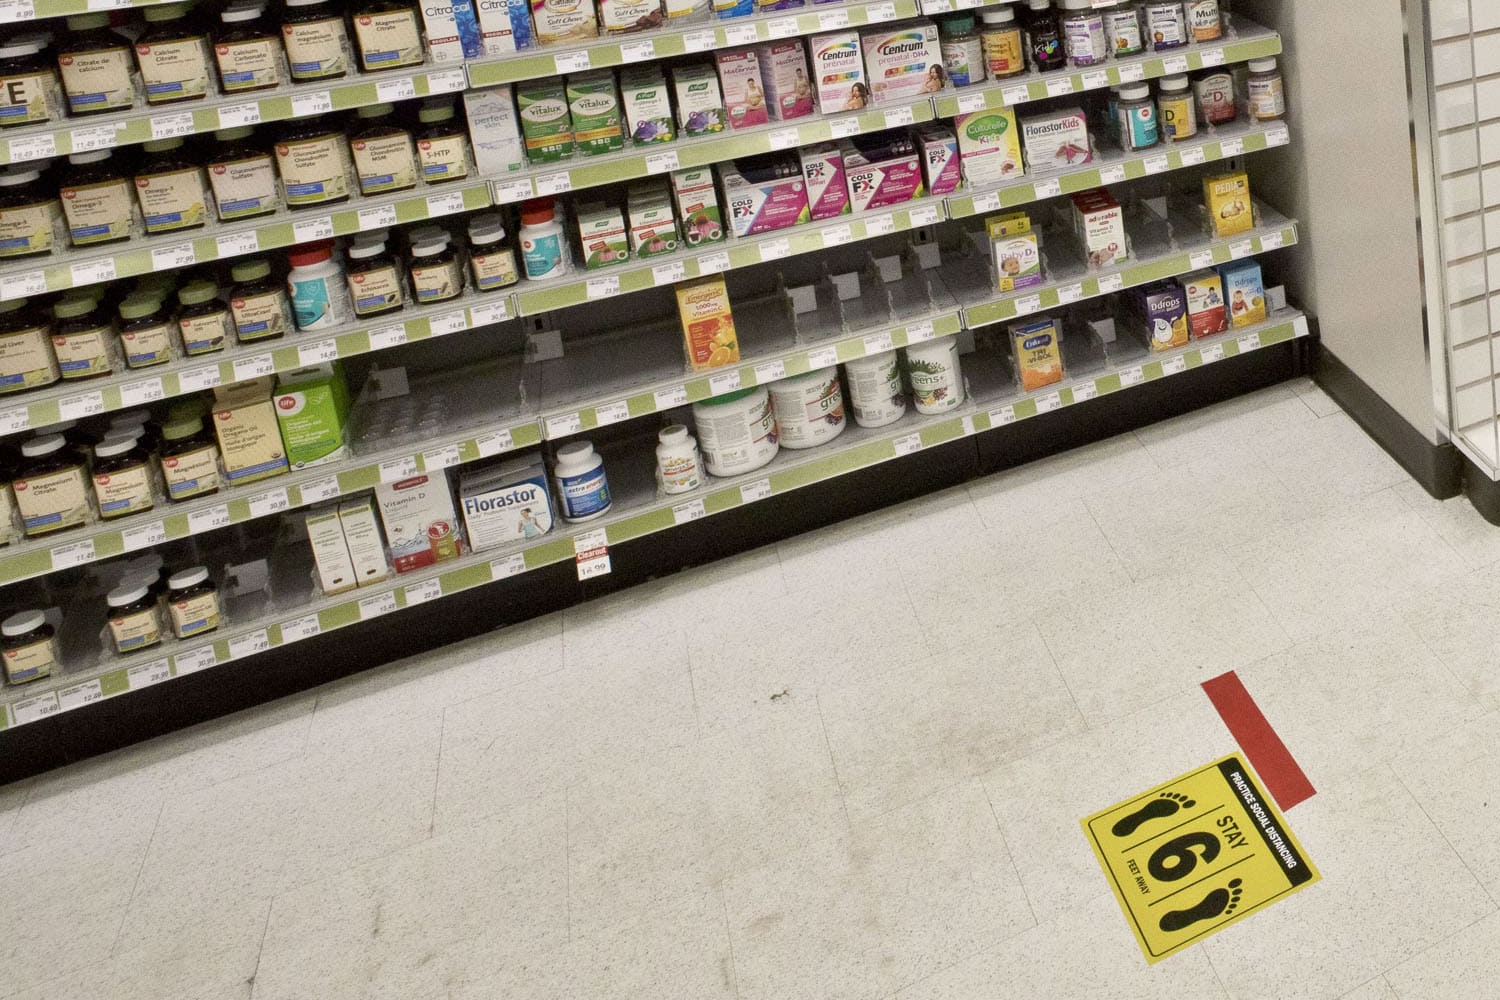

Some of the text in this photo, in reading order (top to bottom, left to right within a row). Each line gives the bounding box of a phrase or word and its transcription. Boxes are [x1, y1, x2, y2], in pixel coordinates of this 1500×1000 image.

[425, 4, 470, 17] Citracal
[485, 29, 512, 38] REGULAR
[883, 41, 923, 55] Centrum
[822, 50, 857, 61] Centrum
[823, 58, 856, 69] prenatal
[8, 81, 27, 105] E
[475, 113, 508, 127] perfect
[966, 118, 1007, 135] Culturelle
[1026, 118, 1080, 137] FlorastorKids
[427, 150, 450, 158] 5-HTP
[805, 162, 824, 171] COLD
[851, 173, 873, 183] COLD
[853, 180, 875, 193] FX
[732, 199, 753, 208] COLD
[1000, 250, 1024, 261] Baby
[1151, 298, 1180, 312] Ddrops
[383, 491, 426, 508] Vitamin D
[465, 486, 537, 514] Florastor
[577, 546, 608, 561] Clearout
[1230, 771, 1298, 869] PRACTICE SOCIAL DISTANCING
[1216, 815, 1249, 850] STAY
[1148, 832, 1221, 882] 6
[1127, 859, 1151, 895] FEET AWAY
